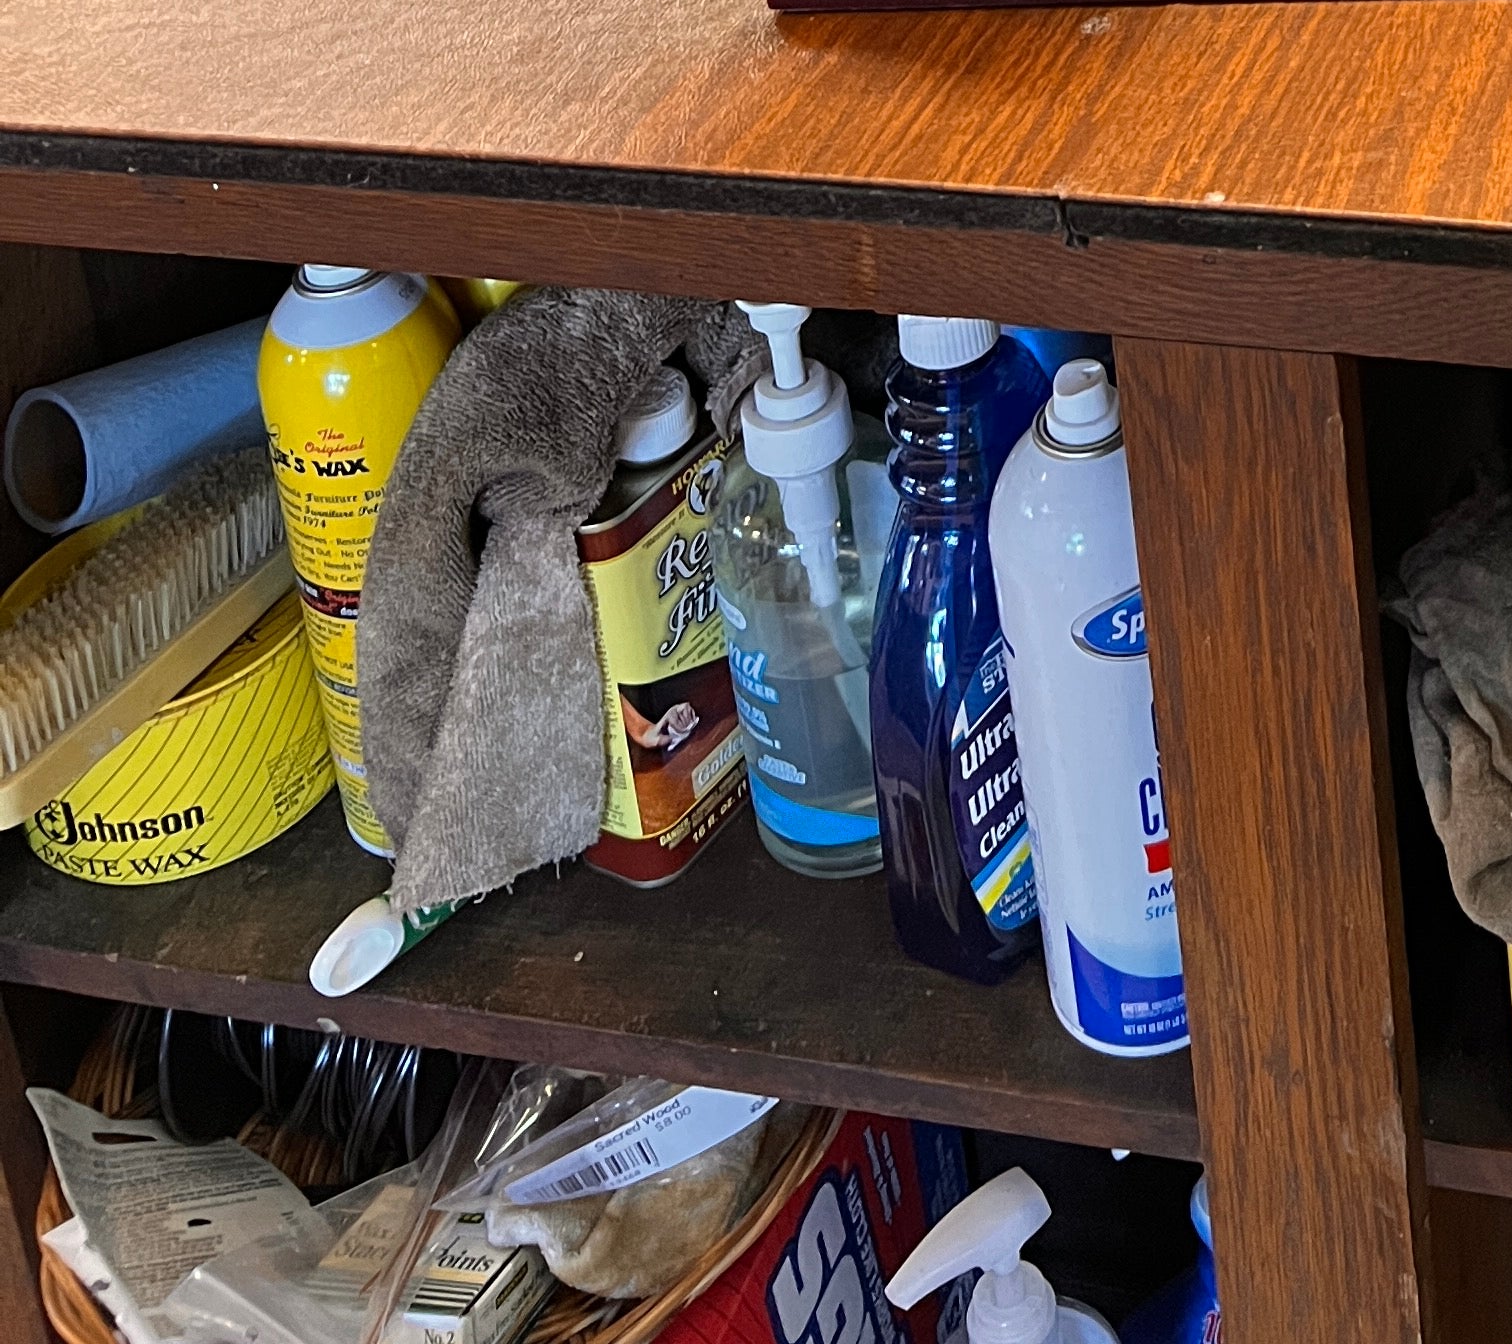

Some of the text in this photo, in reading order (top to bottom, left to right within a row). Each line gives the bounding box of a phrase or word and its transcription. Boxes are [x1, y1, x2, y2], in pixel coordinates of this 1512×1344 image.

[304, 437, 365, 458] Original
[317, 427, 345, 441] The
[311, 457, 370, 477] WAX
[960, 713, 1014, 780] Ultra
[35, 800, 206, 845] Johnson
[38, 843, 211, 878] PASTE WAX
[594, 1098, 681, 1152] Sacred Wood
